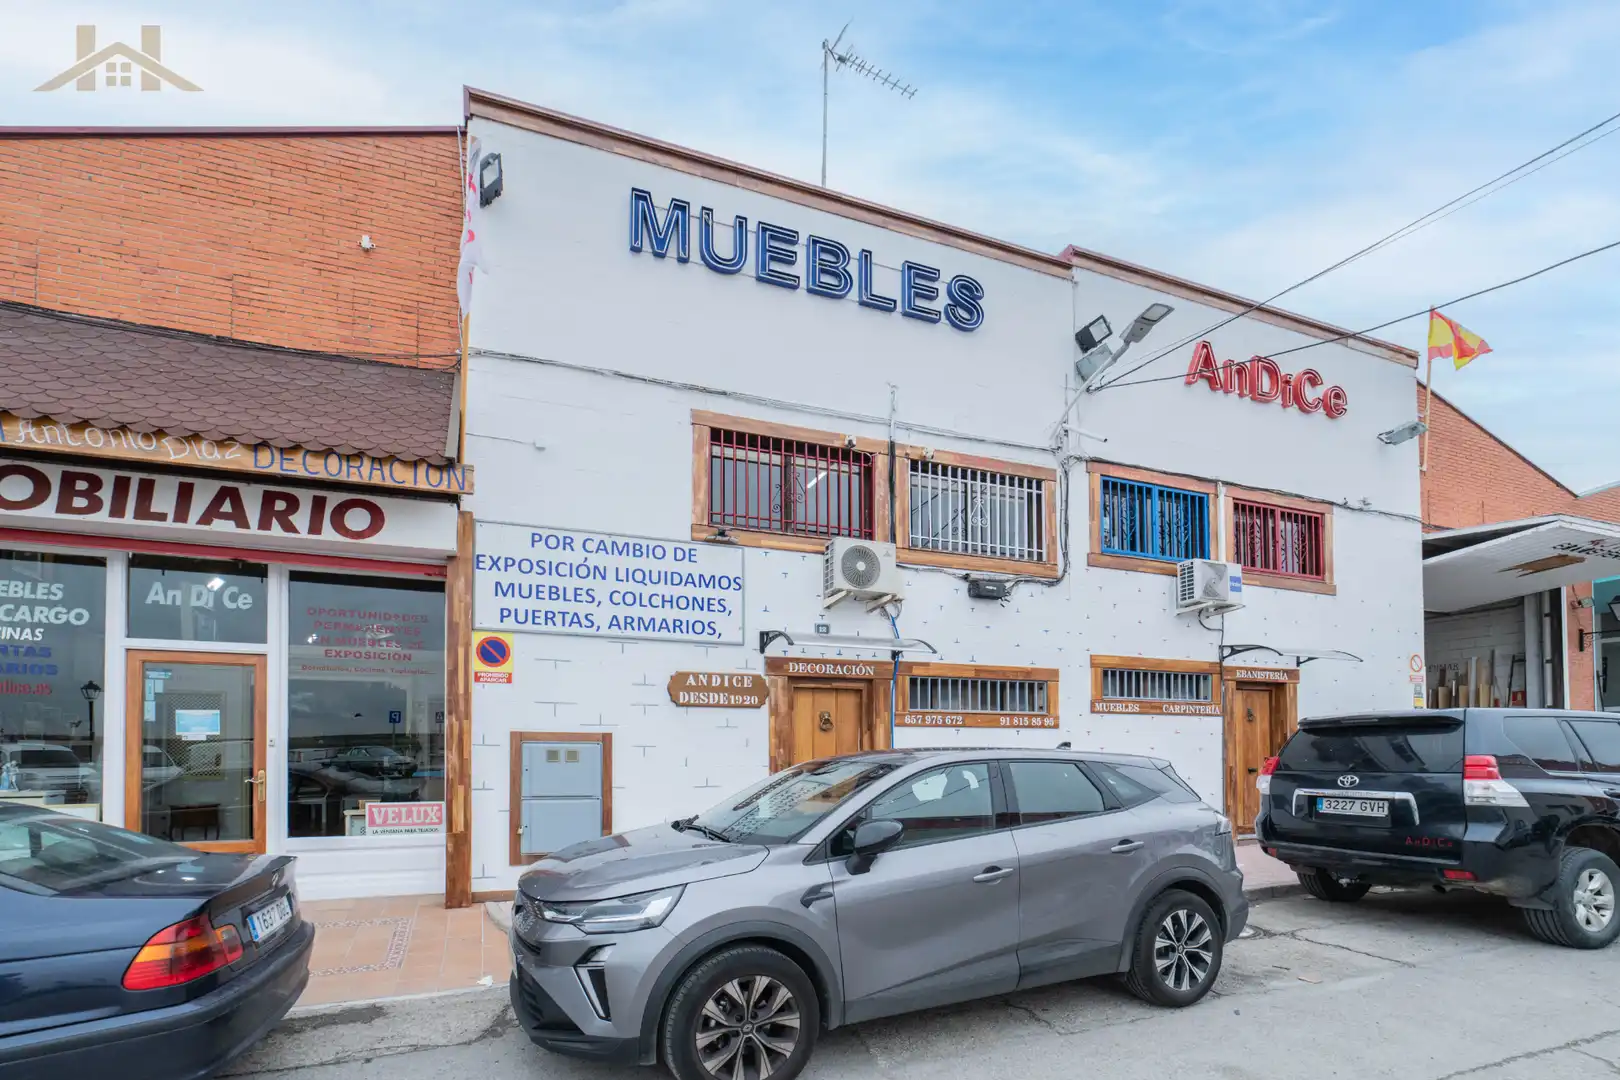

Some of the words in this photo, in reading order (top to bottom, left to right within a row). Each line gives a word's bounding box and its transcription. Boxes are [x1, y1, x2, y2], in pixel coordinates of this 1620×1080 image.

[630, 187, 984, 332] MUEBLES
[1184, 340, 1348, 419] AnDiCe
[0, 464, 386, 541] OBILIARIO
[531, 532, 575, 552] POR
[582, 537, 667, 560] CAMBIO
[673, 547, 698, 563] DE
[475, 553, 607, 581] EXPOSICIÓN
[615, 566, 742, 592] LIQUIDAMOS
[144, 581, 182, 606] An
[190, 584, 215, 609] Di
[222, 586, 253, 610] Ce
[494, 581, 602, 607] MUEBLES,
[609, 590, 732, 617] COLCHONES,
[0, 604, 90, 626] CARGO
[500, 607, 601, 632] PUERTAS,
[607, 614, 722, 639] ARMARIOS,
[0, 626, 45, 641] INAS
[788, 661, 876, 676] DECORACIÓN
[1236, 669, 1289, 681] EBANISTERÍA
[686, 674, 753, 688] ANDICE
[679, 691, 728, 705] DESDE
[729, 694, 759, 705] 1920
[1094, 702, 1141, 713] MUEBLES
[1162, 703, 1221, 715] CARPINTERÍA
[904, 715, 923, 725] 657
[925, 715, 943, 725] 975
[945, 715, 963, 725] 672
[1000, 716, 1010, 726] 91
[1013, 716, 1029, 726] 815
[1031, 717, 1042, 726] 85
[372, 806, 440, 825] VELUX
[1325, 799, 1356, 811] 3227
[1360, 801, 1386, 813] GVH
